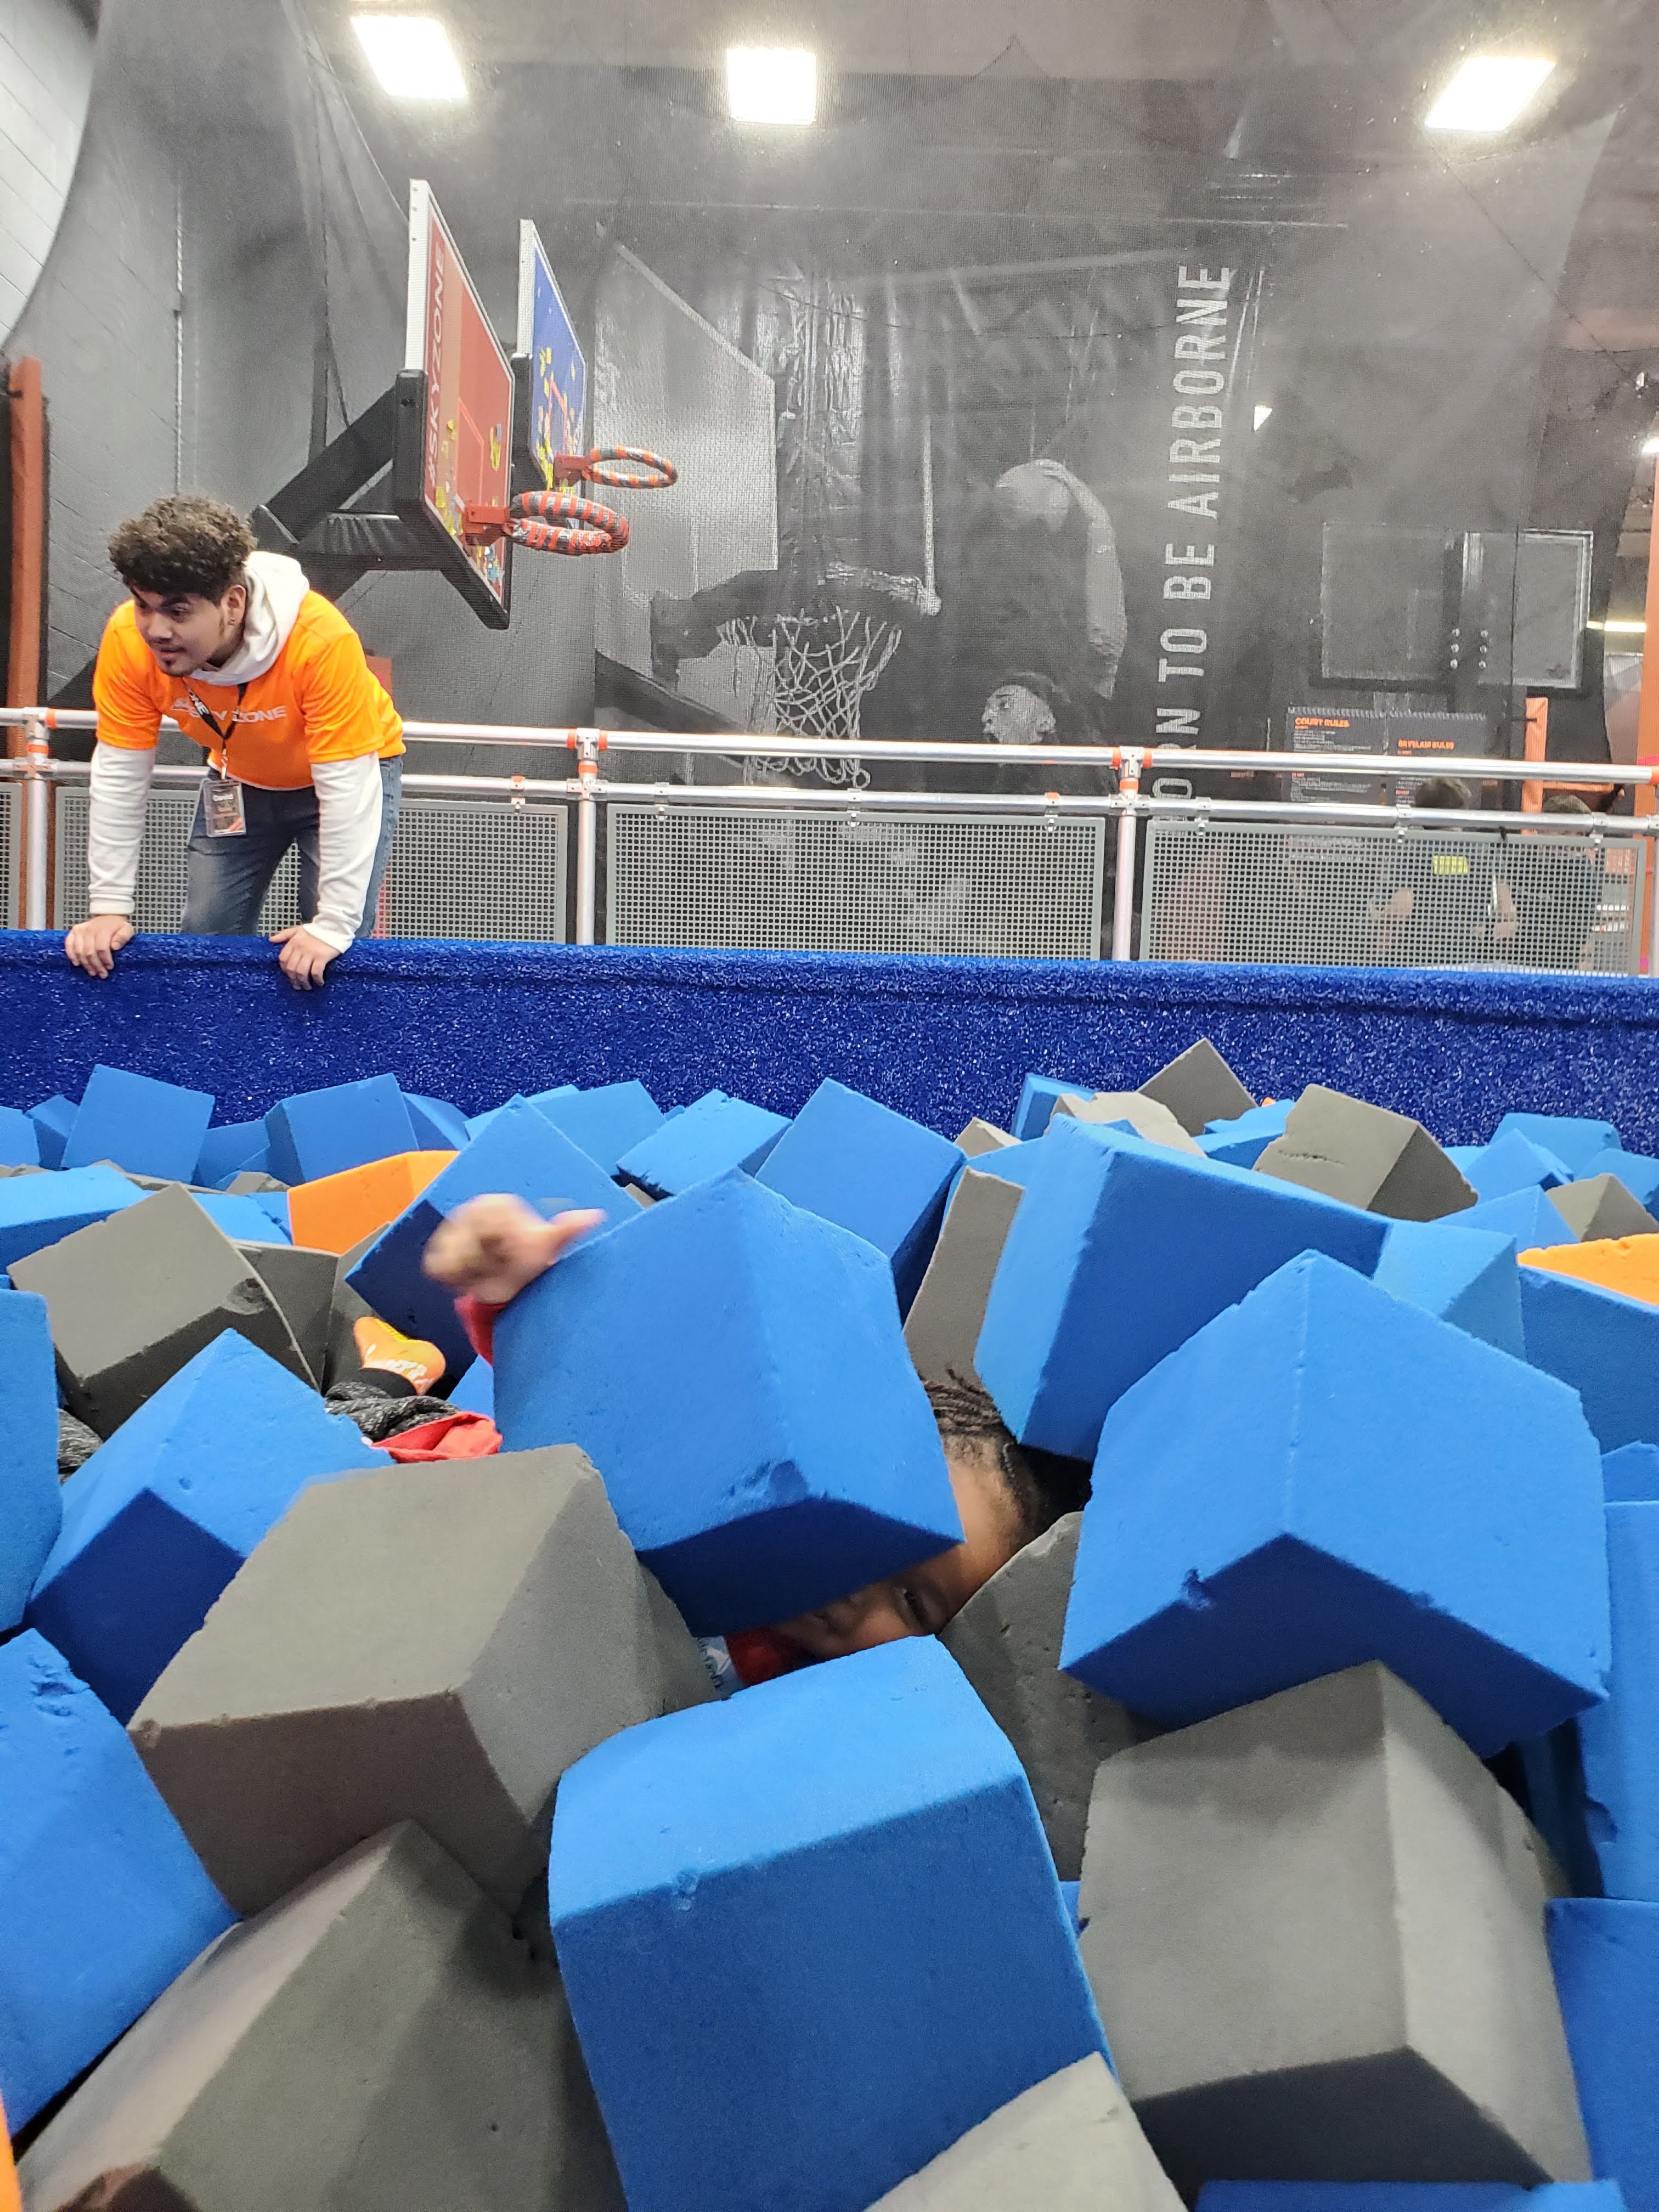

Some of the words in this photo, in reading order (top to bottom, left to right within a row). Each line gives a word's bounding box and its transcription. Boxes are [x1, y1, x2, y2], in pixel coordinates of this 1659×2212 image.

[1167, 266, 1231, 520] AIRBORNE
[1163, 543, 1215, 601] BE
[1158, 628, 1208, 684] TO
[1152, 707, 1201, 821] ON
